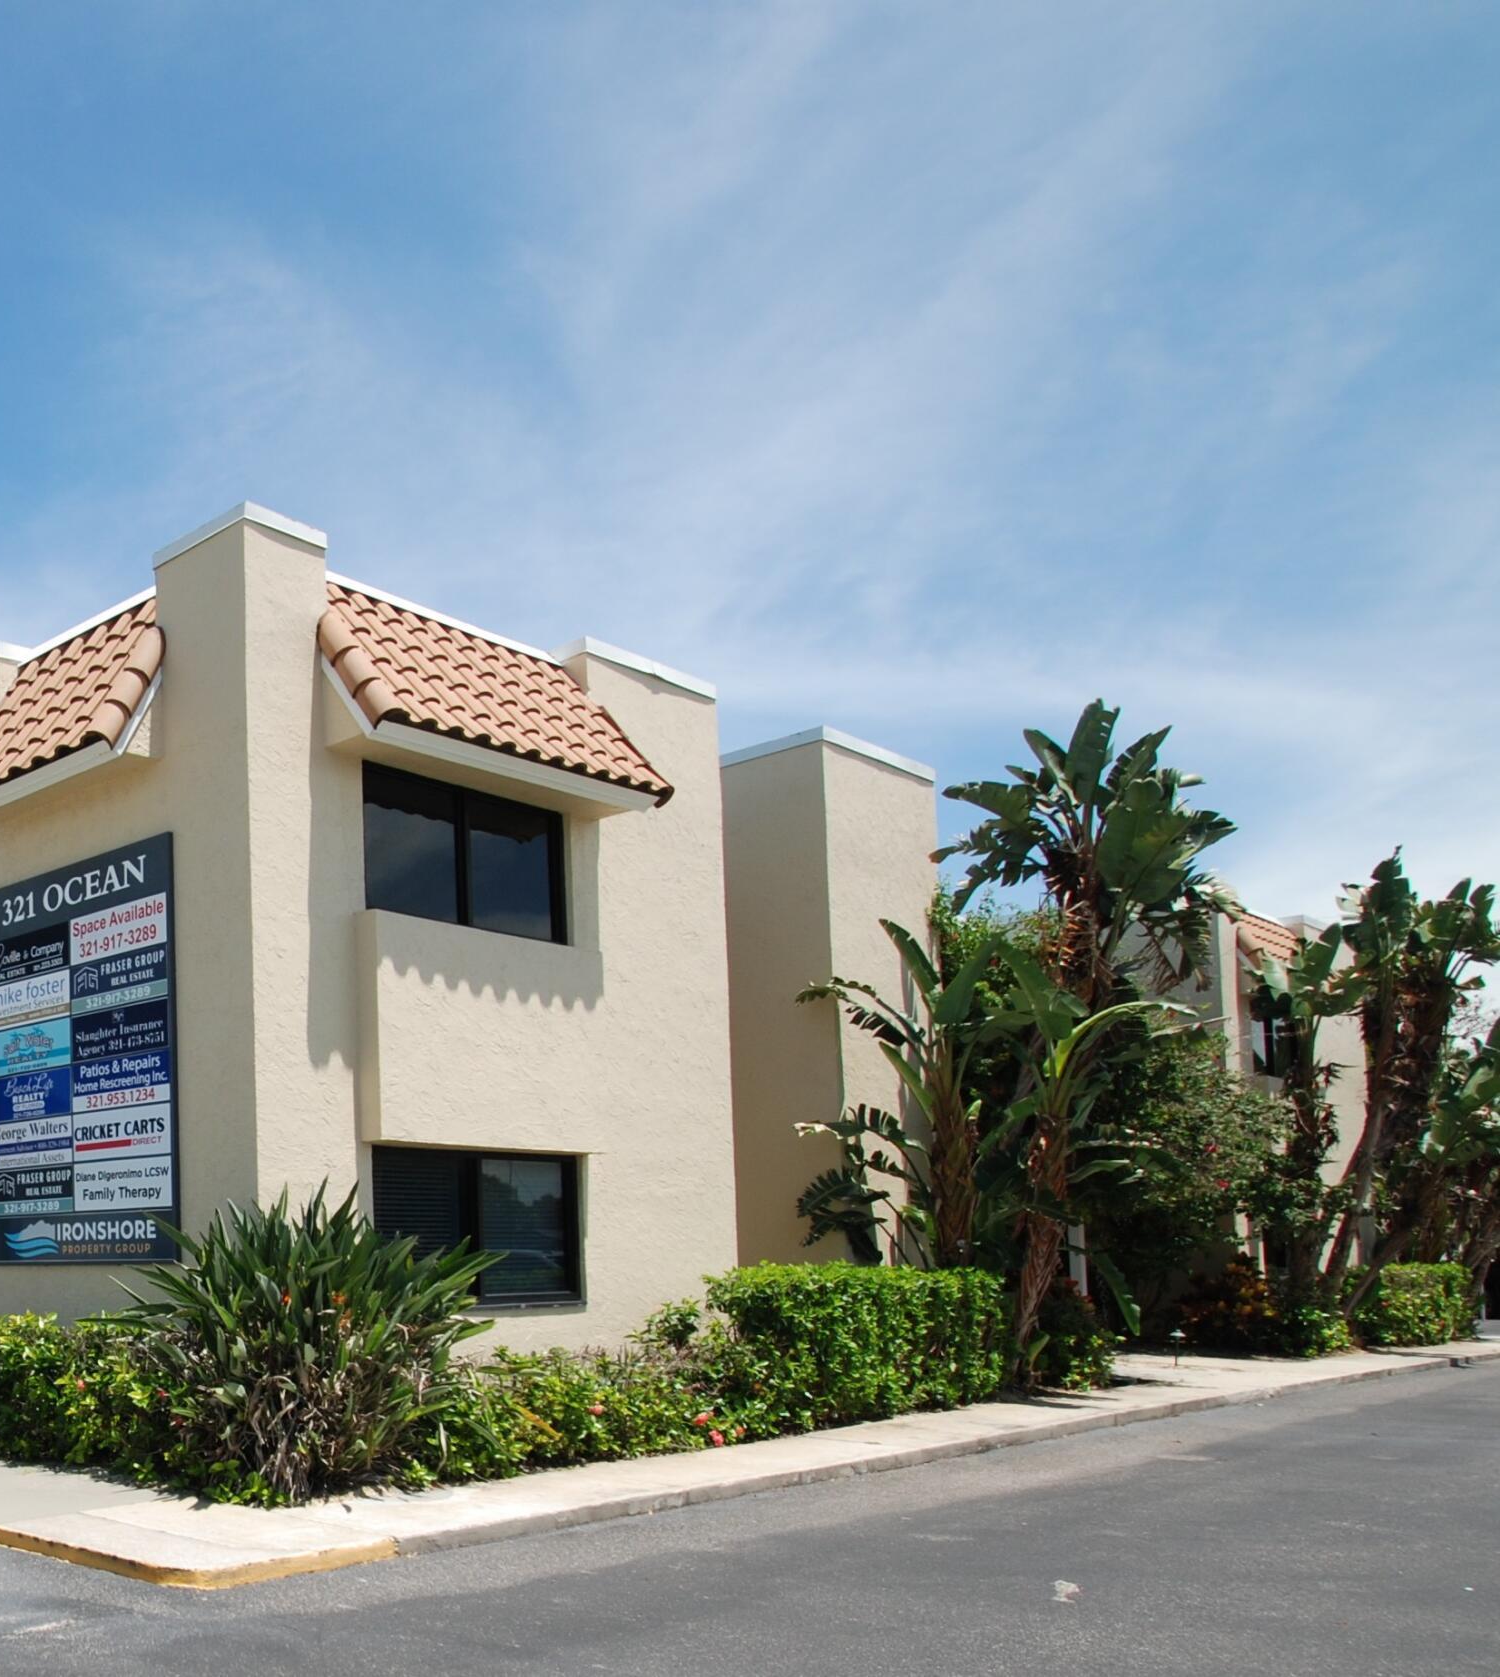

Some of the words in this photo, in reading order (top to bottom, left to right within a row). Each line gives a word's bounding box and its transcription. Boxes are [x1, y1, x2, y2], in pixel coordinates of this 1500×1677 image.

[2, 891, 36, 926] 321
[43, 854, 147, 912] OCEAN
[72, 917, 106, 939] Space
[109, 899, 164, 927] Available
[30, 940, 64, 958] Company
[79, 924, 157, 958] 321-917-3289
[100, 957, 132, 976] FRASER
[134, 949, 164, 967] GROUP
[110, 974, 127, 986] REAL
[129, 968, 154, 982] ESTATE
[26, 978, 65, 999] foster
[85, 986, 151, 1009] 321-917-3289
[119, 1020, 164, 1035] Insurance
[80, 1063, 110, 1079] Patios
[111, 1060, 120, 1074] &
[122, 1055, 161, 1074] Repairs
[74, 1081, 98, 1094] Home
[99, 1072, 151, 1089] Rescreening
[152, 1070, 168, 1081] Inc.
[12, 1092, 45, 1104] REALTY
[86, 1087, 156, 1109] 321.953.1234
[29, 1120, 68, 1137] Walters
[74, 1122, 121, 1142] CRICKET
[124, 1117, 165, 1136] CARTS
[132, 1136, 162, 1146] DIRECT
[42, 1152, 65, 1165] Assets
[16, 1172, 44, 1185] FRASER
[46, 1169, 72, 1182] GROUP
[75, 1172, 96, 1182] Diane
[98, 1168, 143, 1182] Digeronimo
[144, 1166, 170, 1178] LCSW
[82, 1187, 115, 1202] Family
[118, 1186, 162, 1200] Therapy
[4, 1200, 60, 1214] 321-917-3289
[56, 1219, 157, 1241] IRONSHORE
[62, 1244, 112, 1255] PROPERTY
[115, 1243, 151, 1254] GROUP
